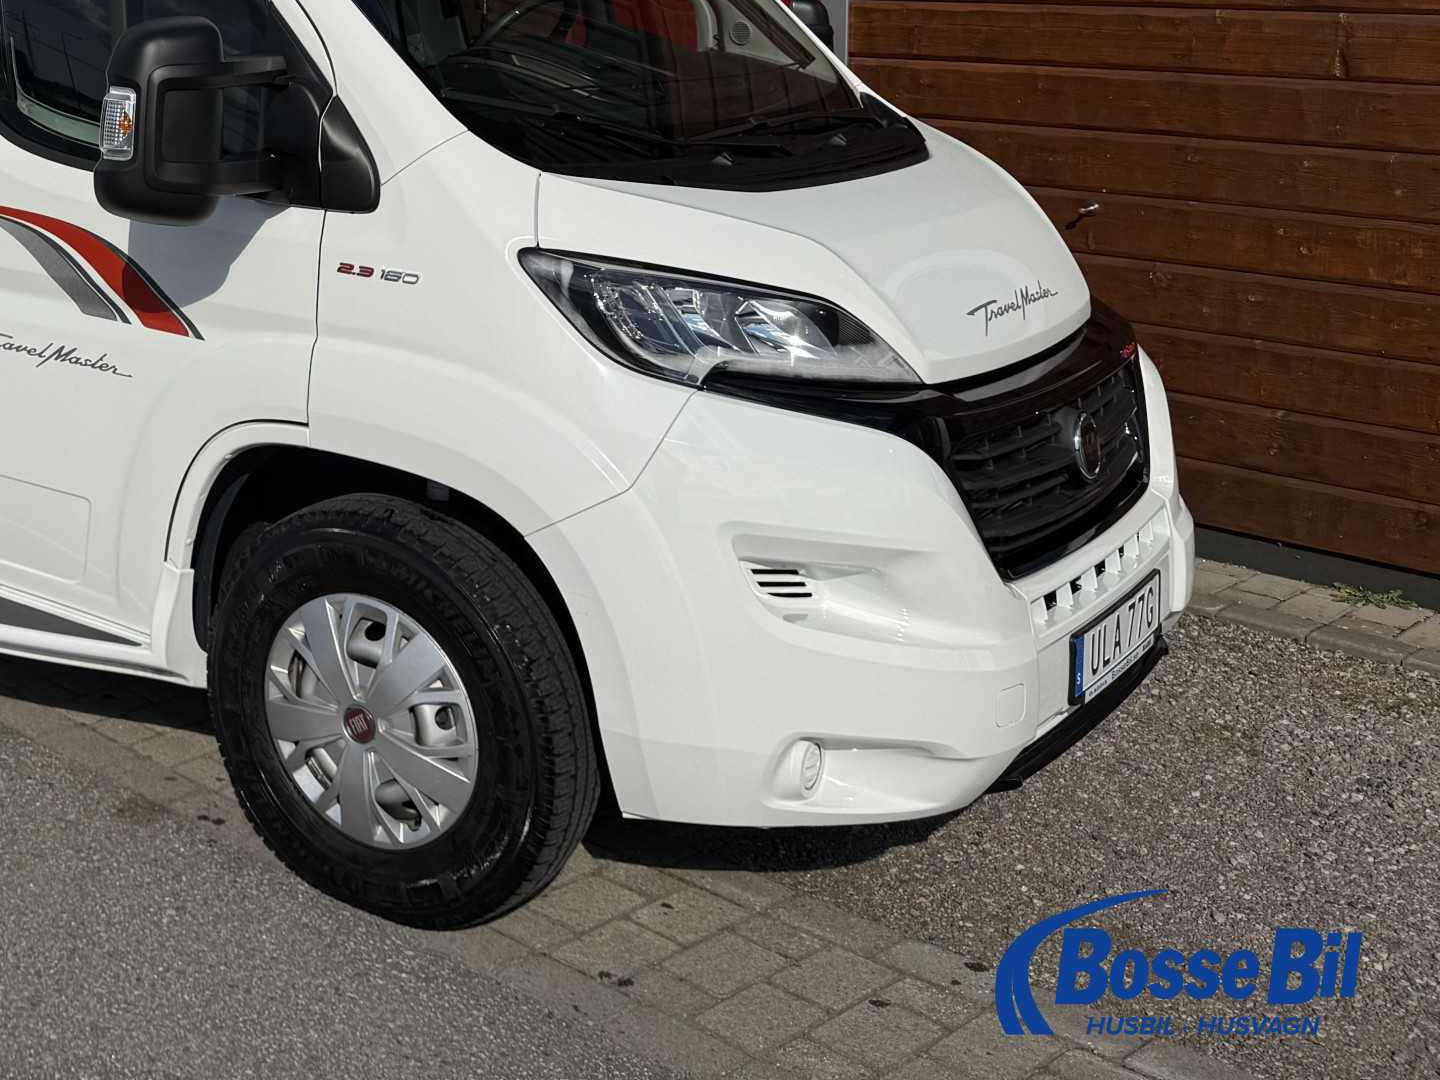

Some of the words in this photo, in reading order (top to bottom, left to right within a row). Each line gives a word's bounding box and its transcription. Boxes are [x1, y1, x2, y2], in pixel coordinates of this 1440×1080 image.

[336, 262, 375, 278] 2.3
[380, 269, 420, 285] 160
[1090, 613, 1122, 677] ULA
[1127, 585, 1154, 648] 77G
[349, 713, 368, 735] FIAT
